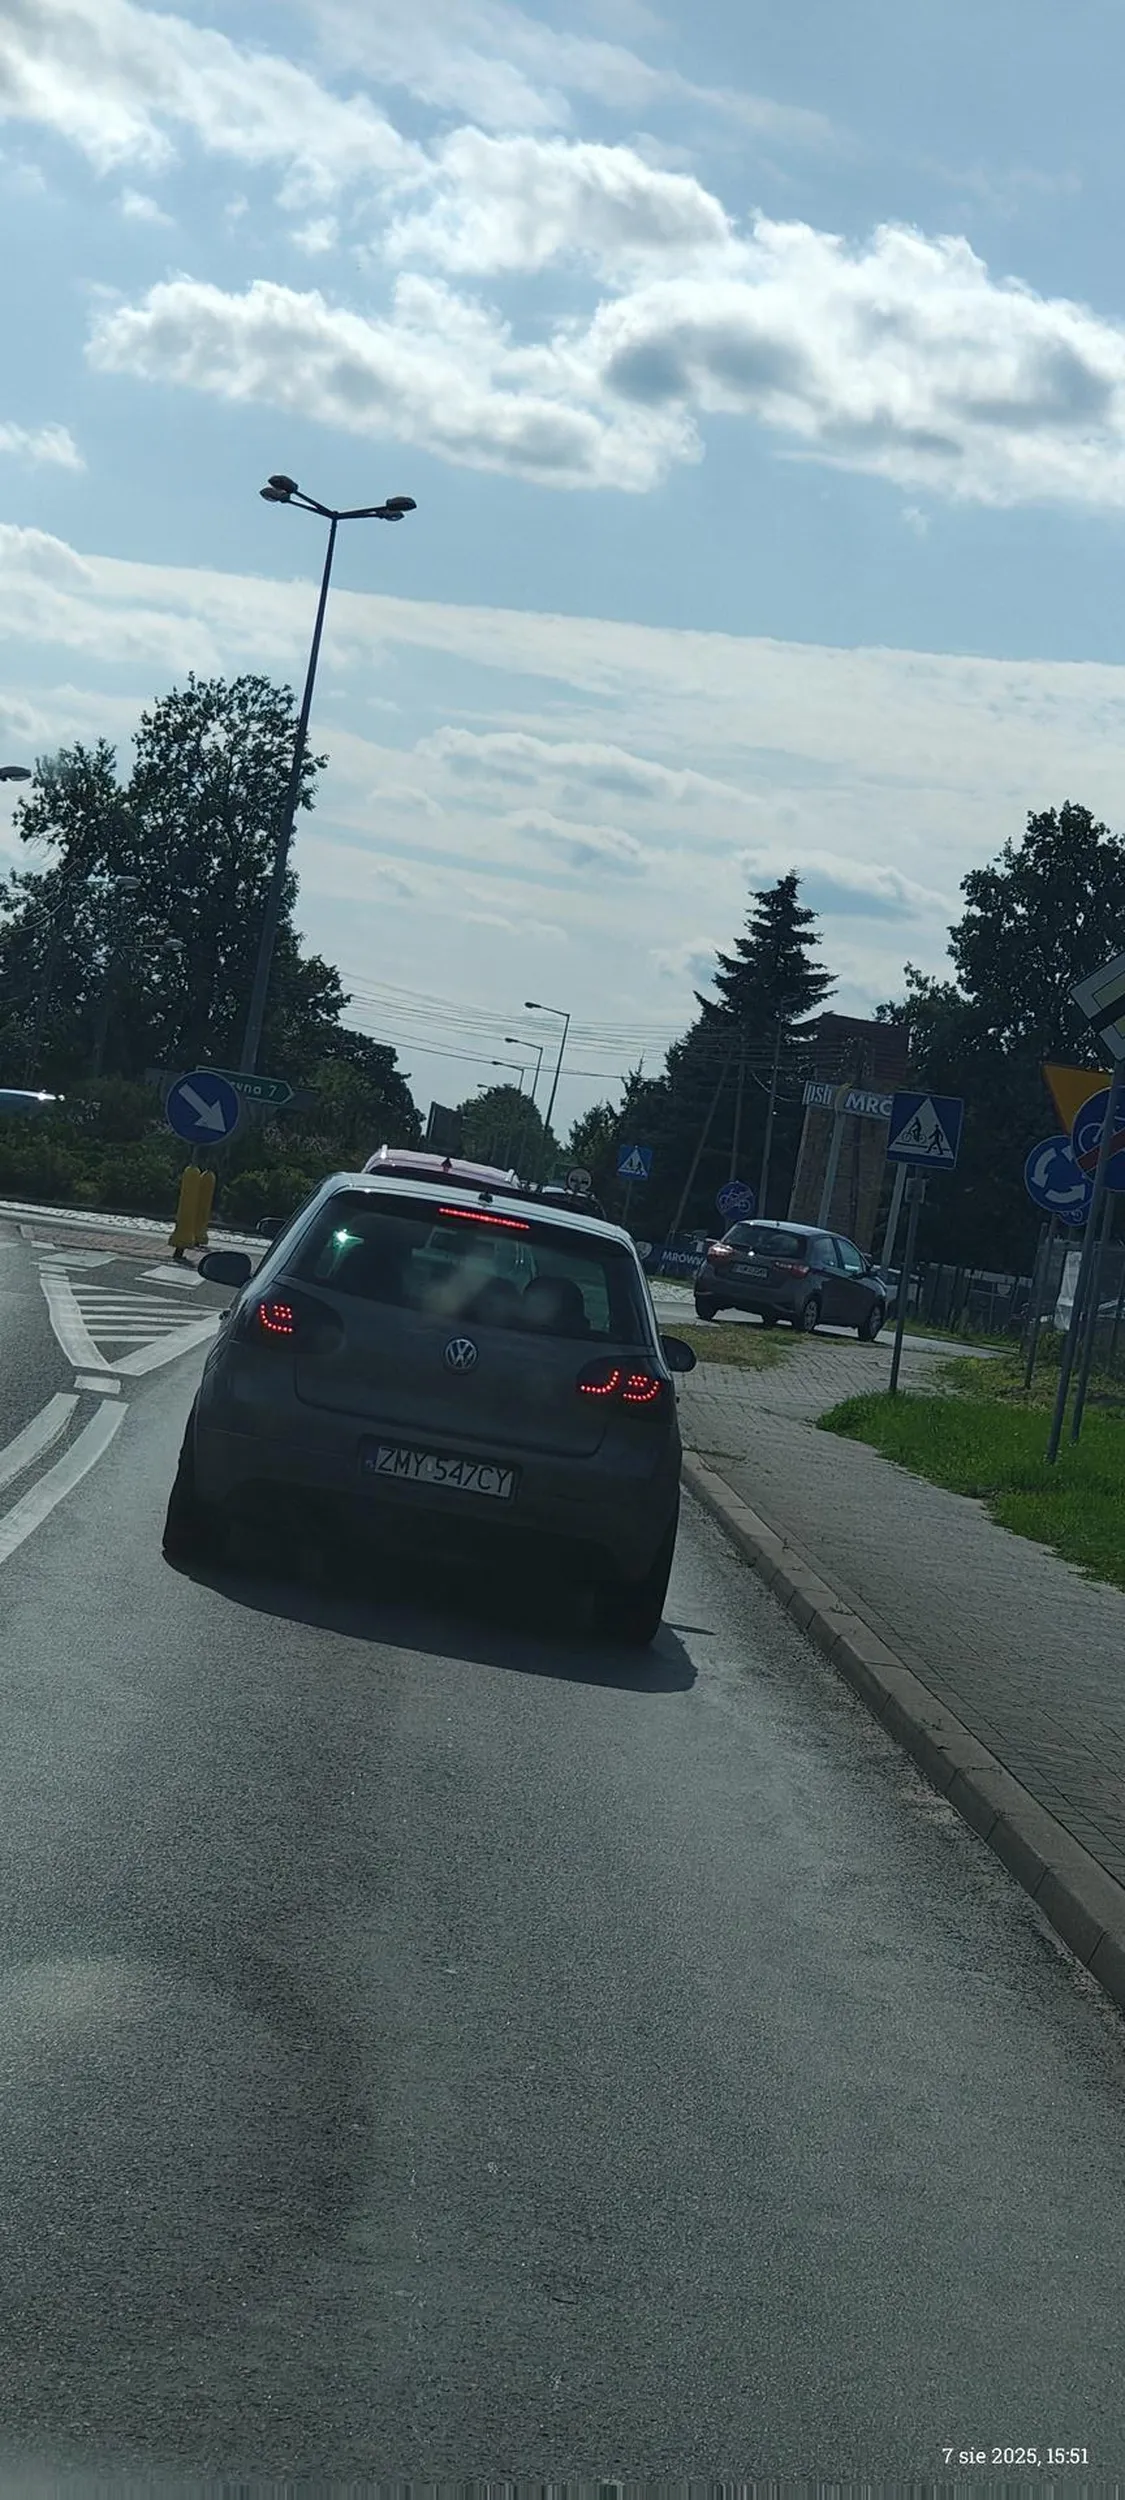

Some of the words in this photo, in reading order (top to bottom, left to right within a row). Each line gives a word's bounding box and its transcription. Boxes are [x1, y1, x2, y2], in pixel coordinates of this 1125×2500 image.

[268, 1084, 278, 1097] 7
[378, 1447, 427, 1477] ZMY
[433, 1458, 515, 1493] 547CY
